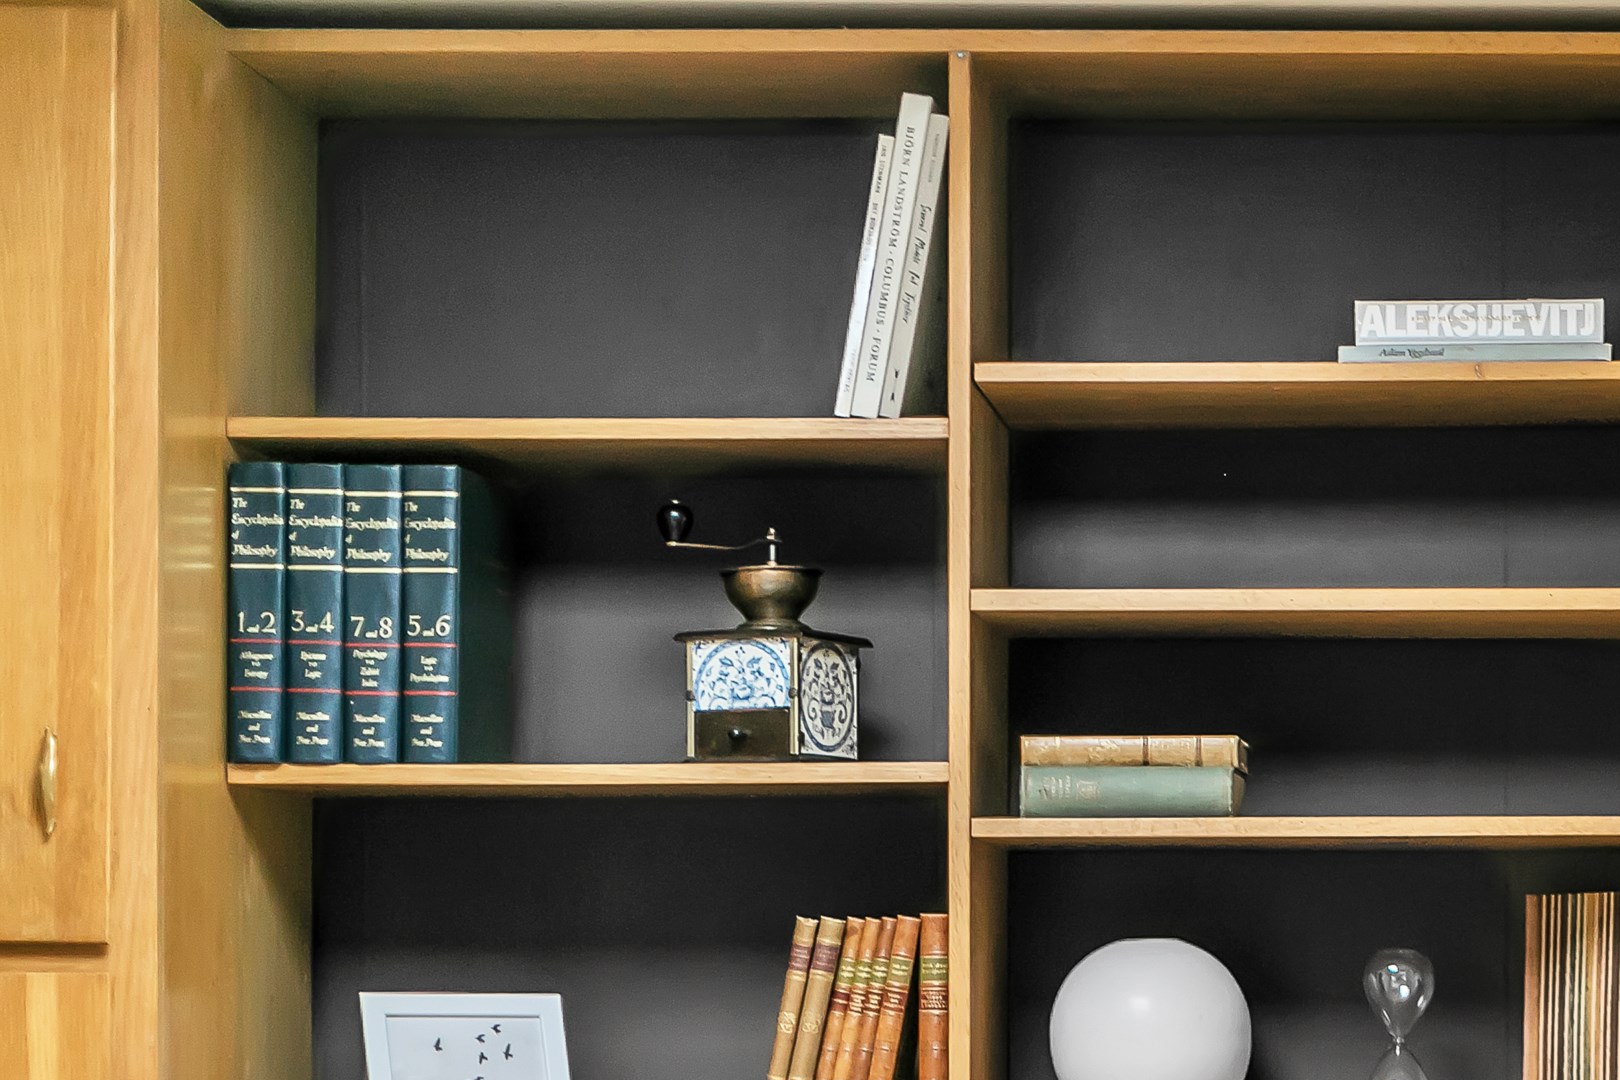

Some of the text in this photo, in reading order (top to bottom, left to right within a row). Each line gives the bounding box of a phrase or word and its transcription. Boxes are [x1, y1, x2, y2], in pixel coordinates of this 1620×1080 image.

[866, 126, 915, 383] BJÖRN LANDSTRÖM COLUMBUS FORUM
[1360, 303, 1595, 338] ALEKSIJEVITJ
[238, 611, 245, 633] 1
[260, 611, 277, 634] 2
[291, 610, 305, 632] 3
[319, 611, 335, 634] 4
[350, 616, 365, 637] 7
[379, 616, 393, 639] 8
[407, 615, 421, 637] 5
[436, 615, 451, 637] 6
